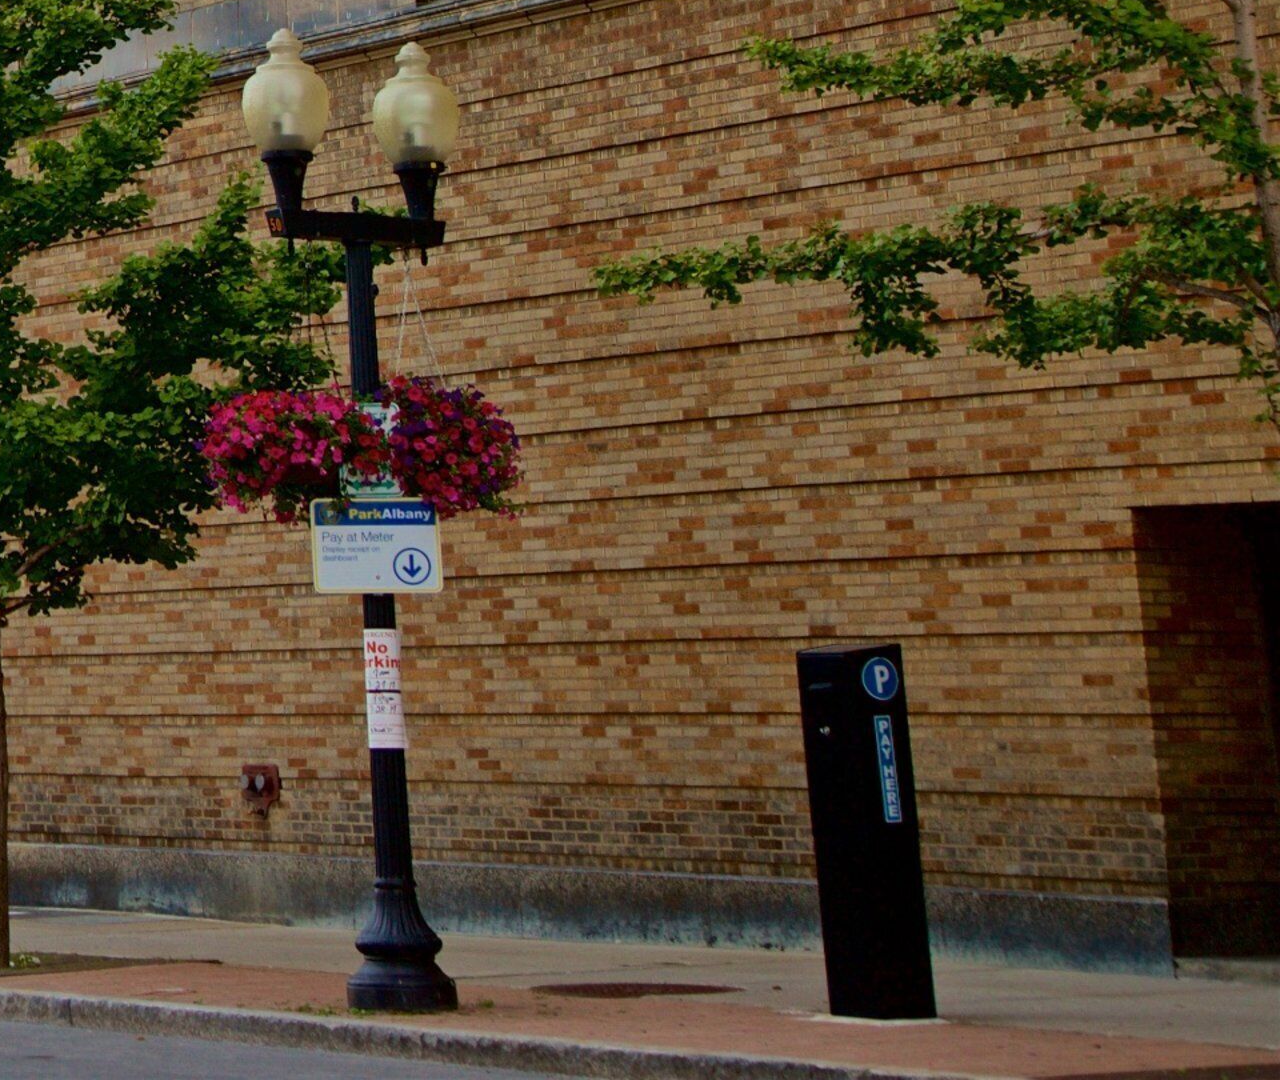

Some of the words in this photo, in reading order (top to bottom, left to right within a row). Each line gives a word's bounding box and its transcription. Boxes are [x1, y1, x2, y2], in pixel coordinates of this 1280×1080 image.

[348, 508, 431, 522] ParkAlbany
[321, 531, 344, 544] Pay
[346, 532, 357, 542] at
[360, 531, 395, 542] Meter
[367, 641, 388, 654] No
[367, 655, 400, 672] rkin
[874, 665, 889, 693] P
[878, 720, 892, 760] PAY
[883, 765, 900, 817] HERE
